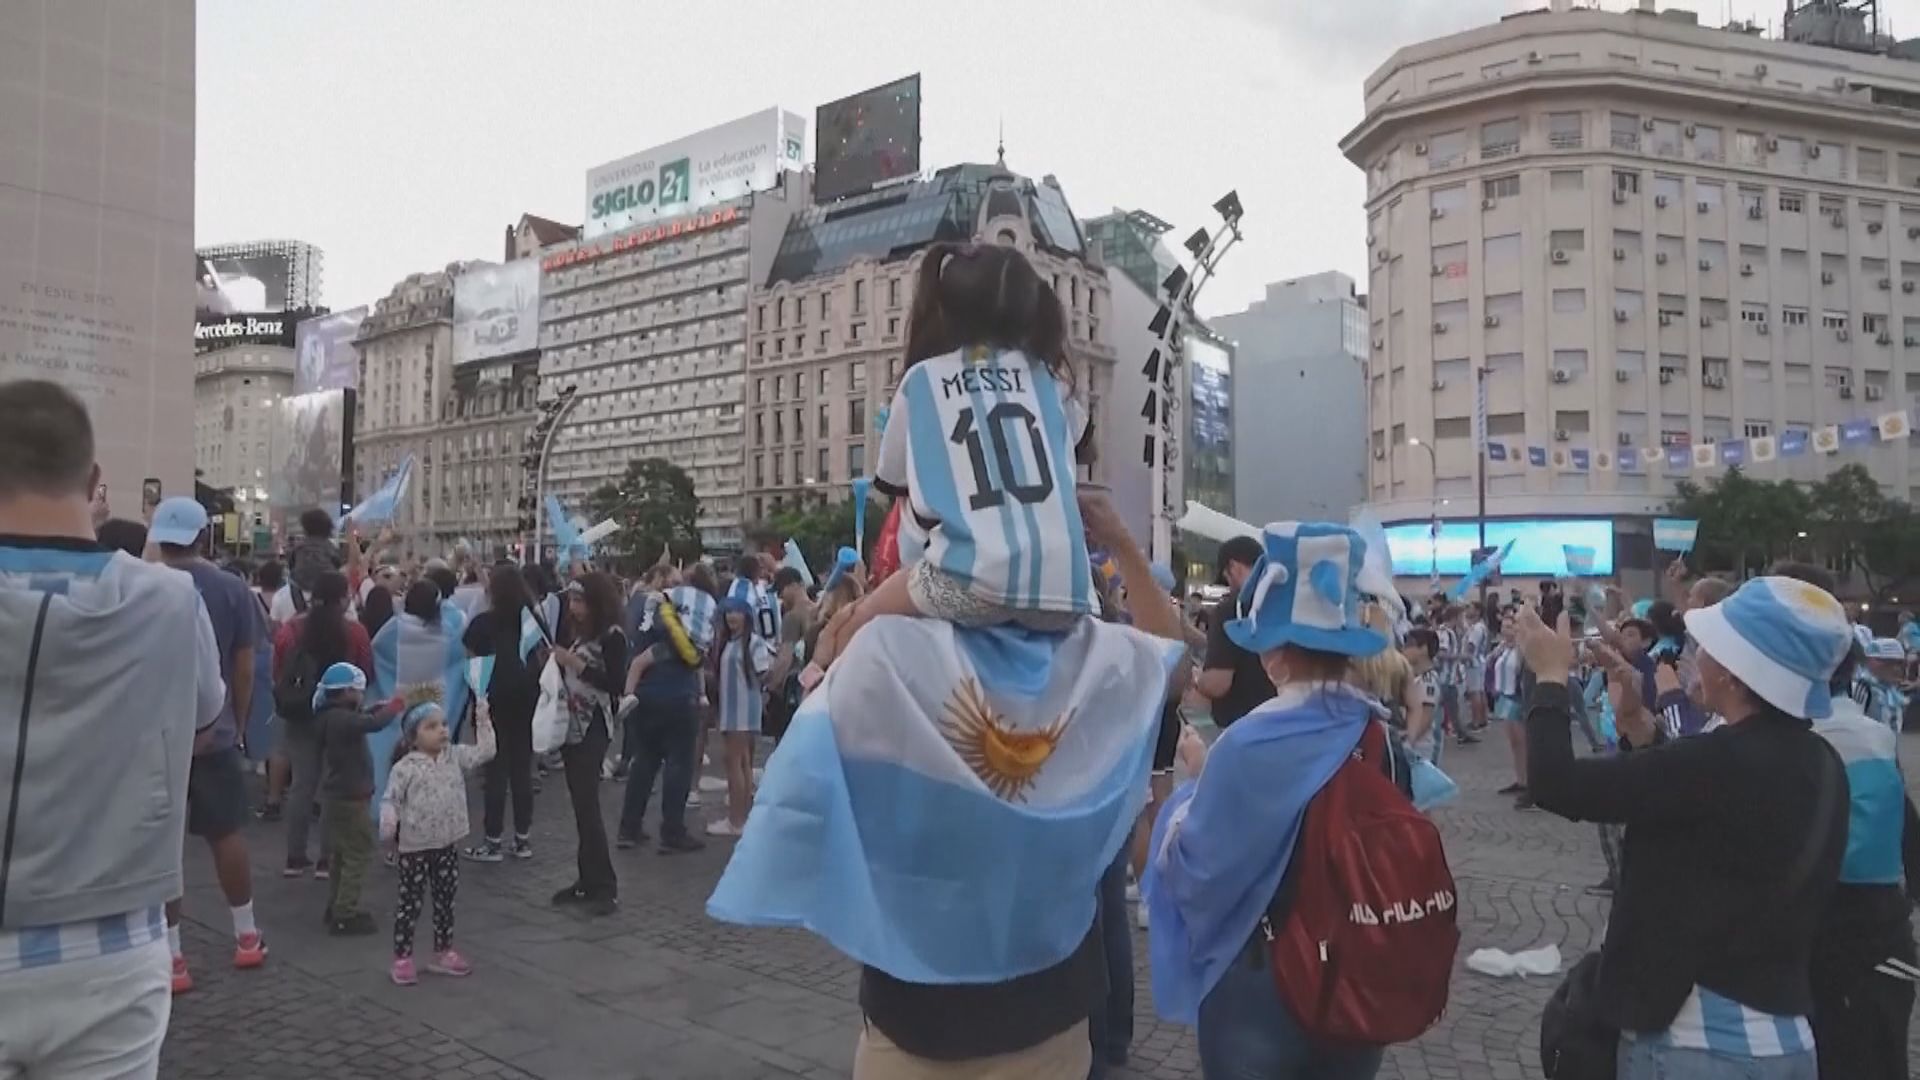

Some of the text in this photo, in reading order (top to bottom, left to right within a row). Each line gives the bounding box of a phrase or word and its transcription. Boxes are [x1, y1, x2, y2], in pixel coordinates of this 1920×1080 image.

[698, 142, 768, 173] La educación
[593, 160, 655, 187] UNIVERSIDAD
[592, 169, 684, 219] SIGLO 21
[941, 368, 1027, 400] MESSI
[950, 402, 1054, 511] 10
[1383, 898, 1425, 925] FILA
